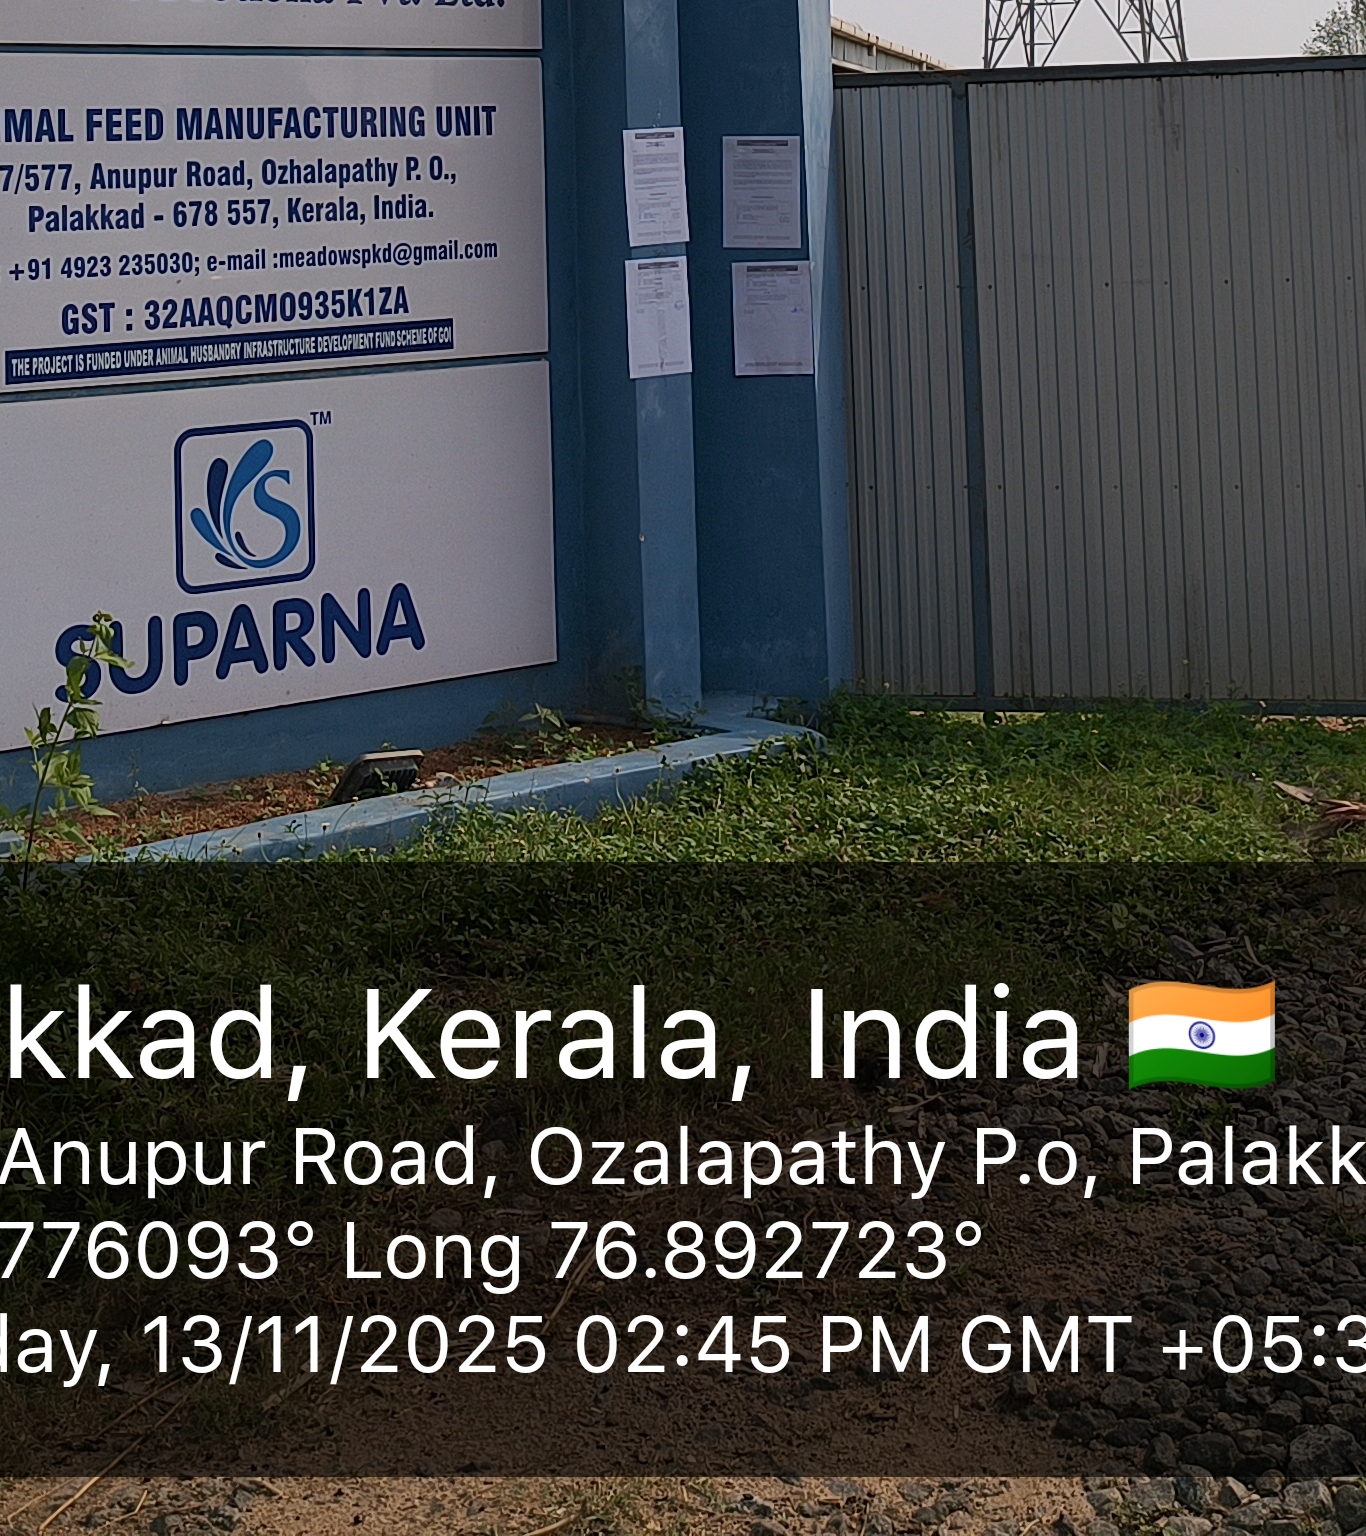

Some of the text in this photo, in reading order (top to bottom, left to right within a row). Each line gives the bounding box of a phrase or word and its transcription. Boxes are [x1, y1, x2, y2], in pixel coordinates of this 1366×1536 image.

[85, 108, 164, 142] FEED
[176, 105, 426, 141] MANUFACTURING
[435, 105, 497, 138] UNIT
[89, 162, 178, 195] Anupur
[186, 159, 253, 191] Road,
[261, 156, 399, 189] Ozhalapathy
[405, 156, 422, 181] P.
[28, 202, 145, 233] Palakkad
[173, 200, 218, 228] 678
[227, 199, 279, 229] 557,
[287, 197, 366, 226] Kerala,
[373, 193, 434, 220] India.
[8, 257, 51, 281] +91
[60, 255, 112, 279] 4923
[118, 251, 200, 277] 235030;
[61, 302, 116, 336] GST
[11, 358, 31, 378] THE
[31, 355, 73, 376] PROJECT
[75, 354, 85, 372] IS
[86, 351, 121, 371] FUNDED
[123, 348, 153, 368] UNDER
[155, 346, 188, 365] ANIMAL
[190, 341, 241, 364] HUSBANDRY
[243, 336, 316, 359] INFRASTRUCTURE
[318, 333, 373, 354] DEVELOPMENT
[375, 331, 395, 348] FUND
[396, 329, 428, 348] SCHEME
[428, 328, 437, 345] OF
[54, 582, 426, 703] SUPARNA
